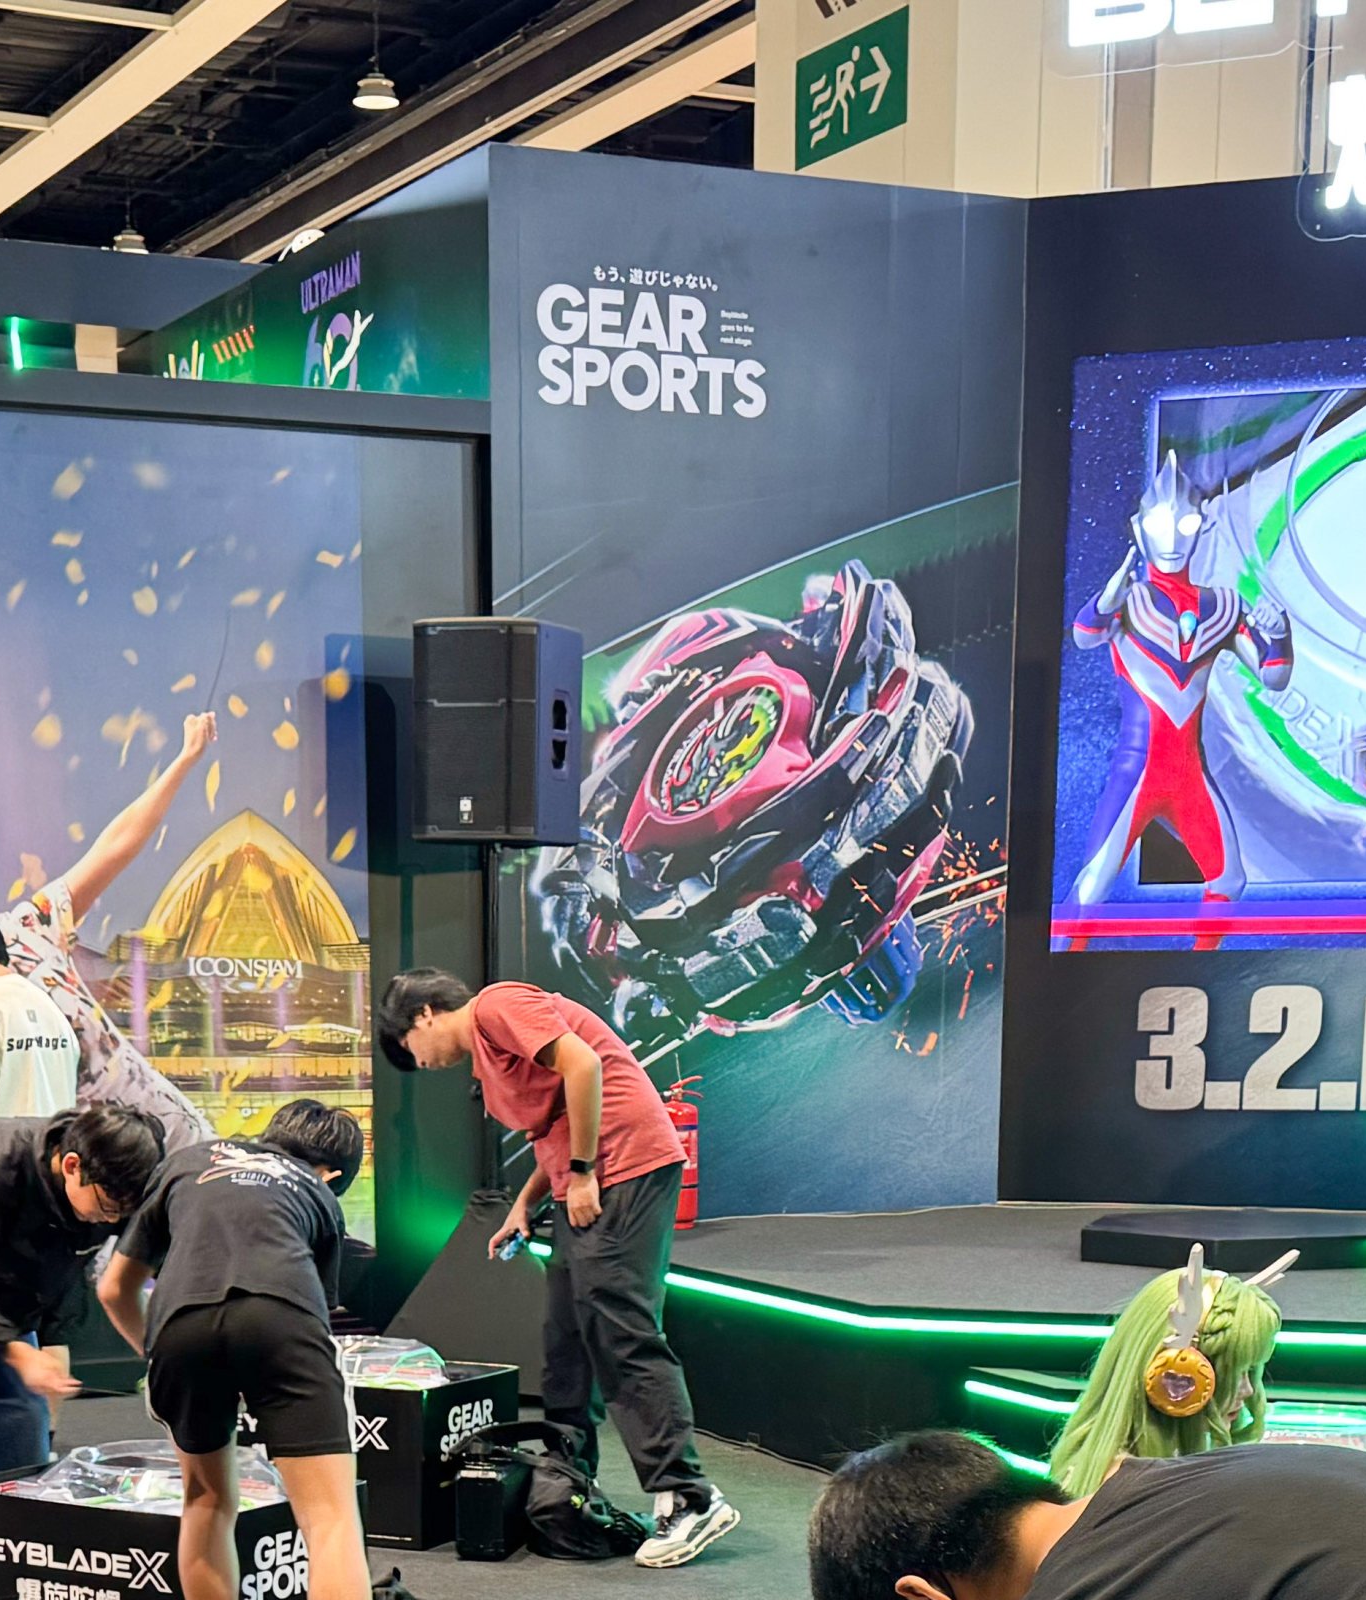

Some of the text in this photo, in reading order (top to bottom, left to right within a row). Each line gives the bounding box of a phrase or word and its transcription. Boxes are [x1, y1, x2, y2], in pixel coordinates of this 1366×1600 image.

[300, 250, 361, 314] ULTRAMAN
[593, 265, 718, 292] もう、遊びじゃない。
[536, 283, 709, 355] GEAR
[537, 344, 767, 418] SPORTS
[448, 1398, 494, 1433] GEAR
